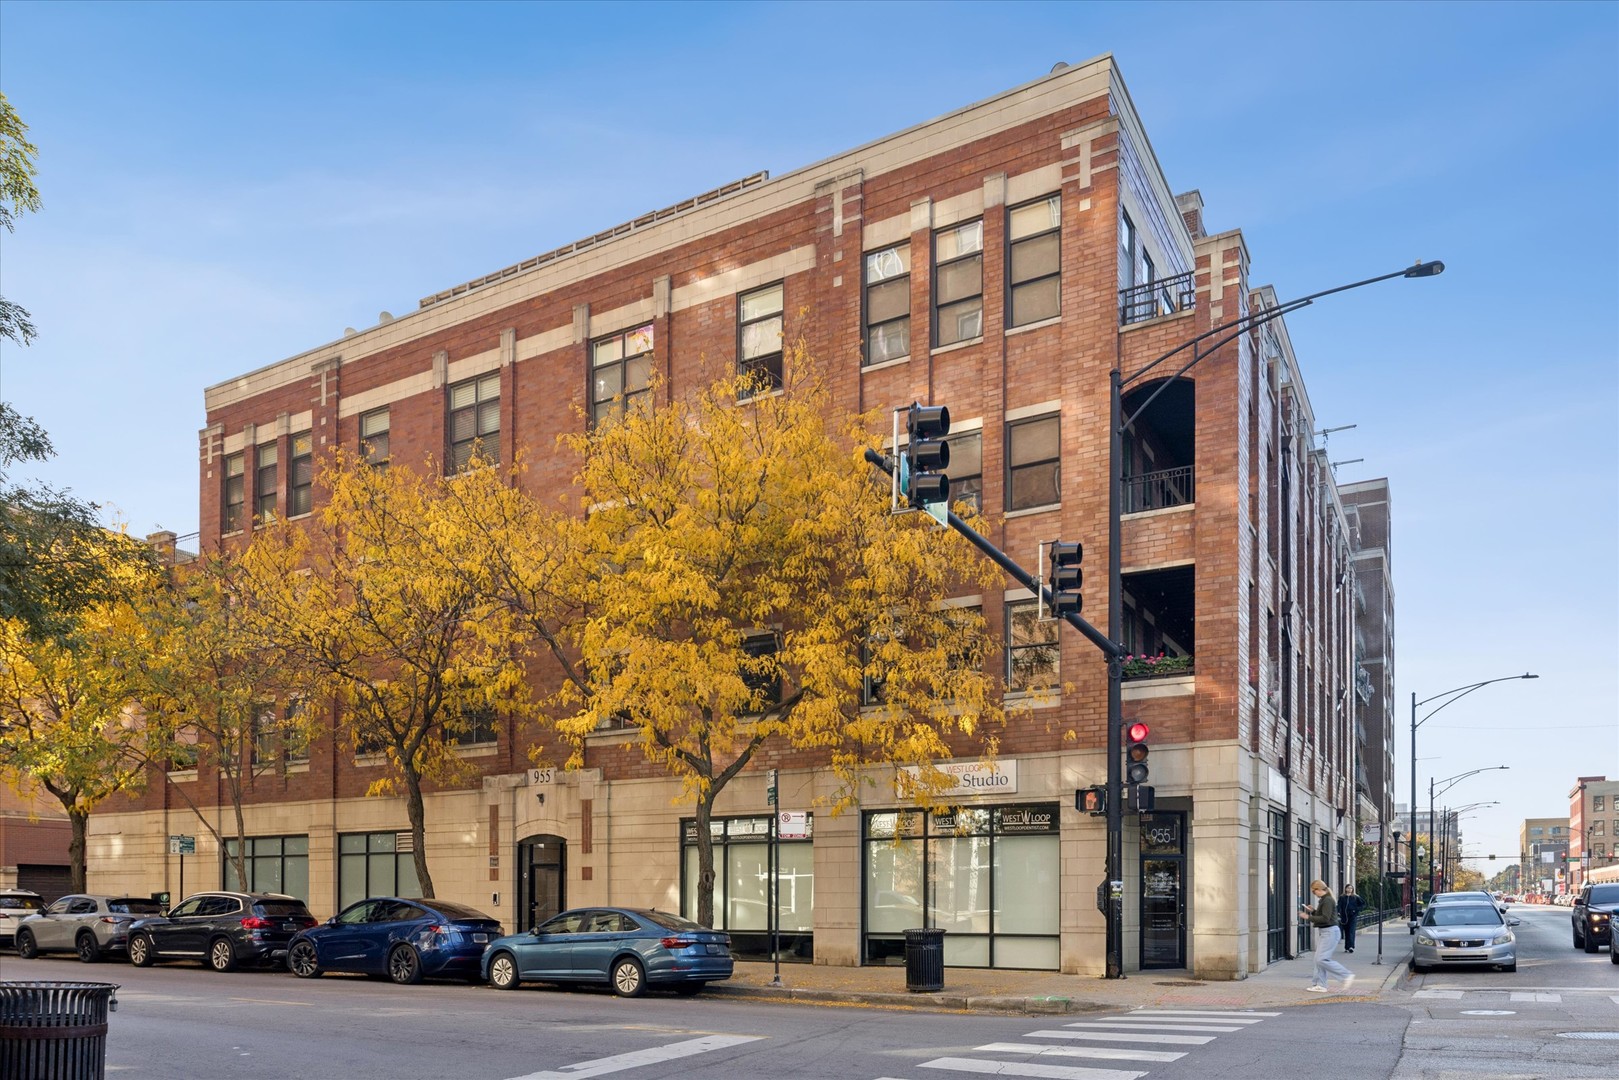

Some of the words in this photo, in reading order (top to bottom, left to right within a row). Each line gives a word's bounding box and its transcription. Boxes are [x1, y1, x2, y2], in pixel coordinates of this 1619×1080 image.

[533, 770, 551, 784] 955
[962, 772, 1009, 788] Studio
[1002, 814, 1020, 823] WEST
[1031, 814, 1051, 823] LOOP
[1151, 828, 1171, 843] 955
